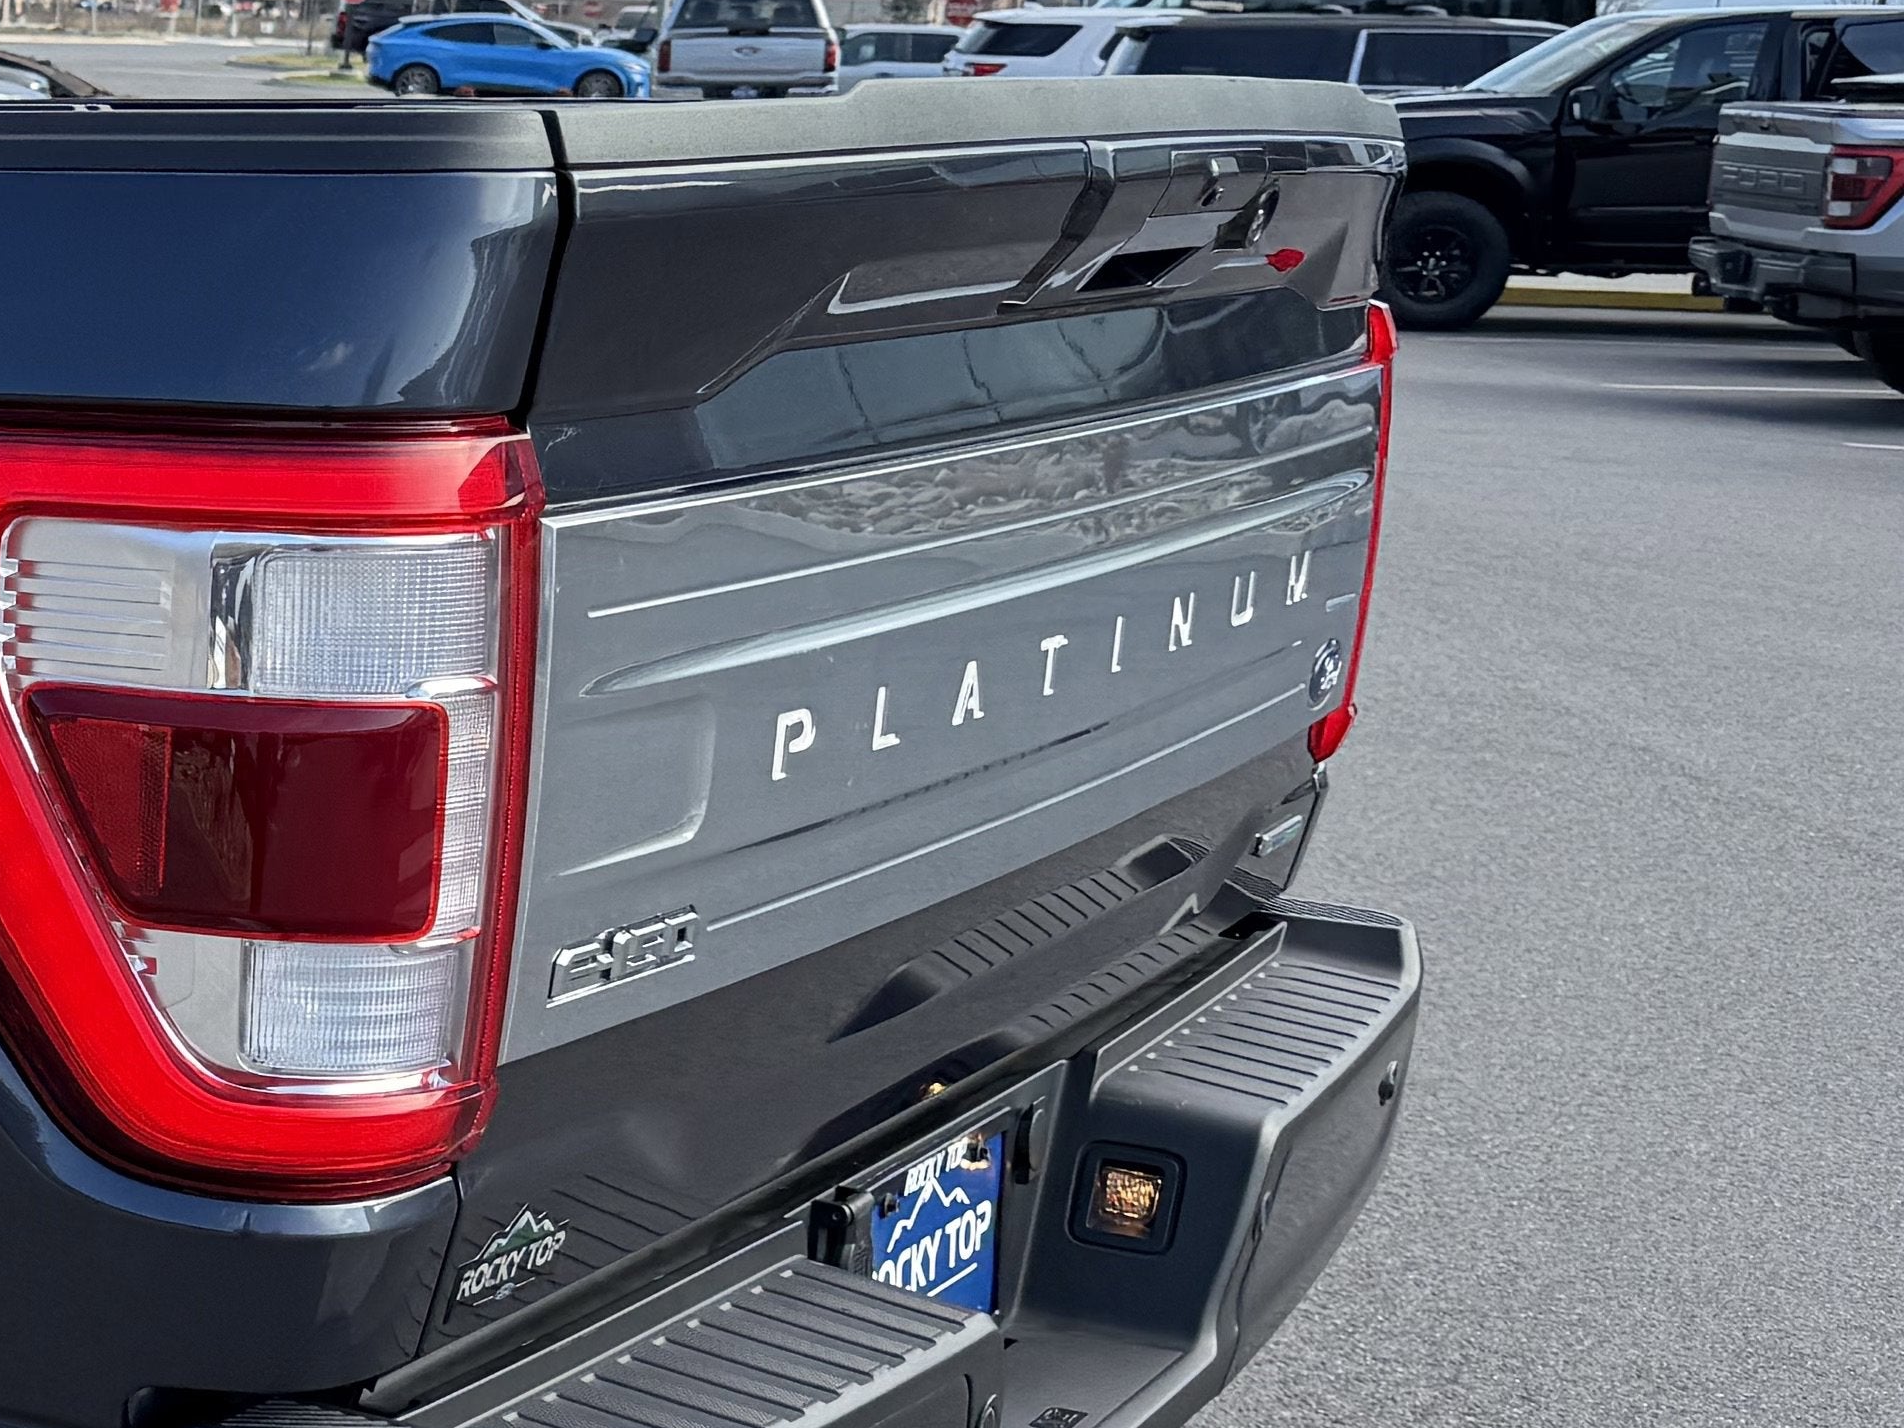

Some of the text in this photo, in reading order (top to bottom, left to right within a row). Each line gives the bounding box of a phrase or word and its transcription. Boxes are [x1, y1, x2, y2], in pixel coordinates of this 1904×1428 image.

[1722, 165, 1804, 193] FORD
[771, 549, 1312, 782] PLATINUM
[456, 1230, 567, 1301] ROCKY TOP
[872, 1199, 992, 1292] OCKY TOP
